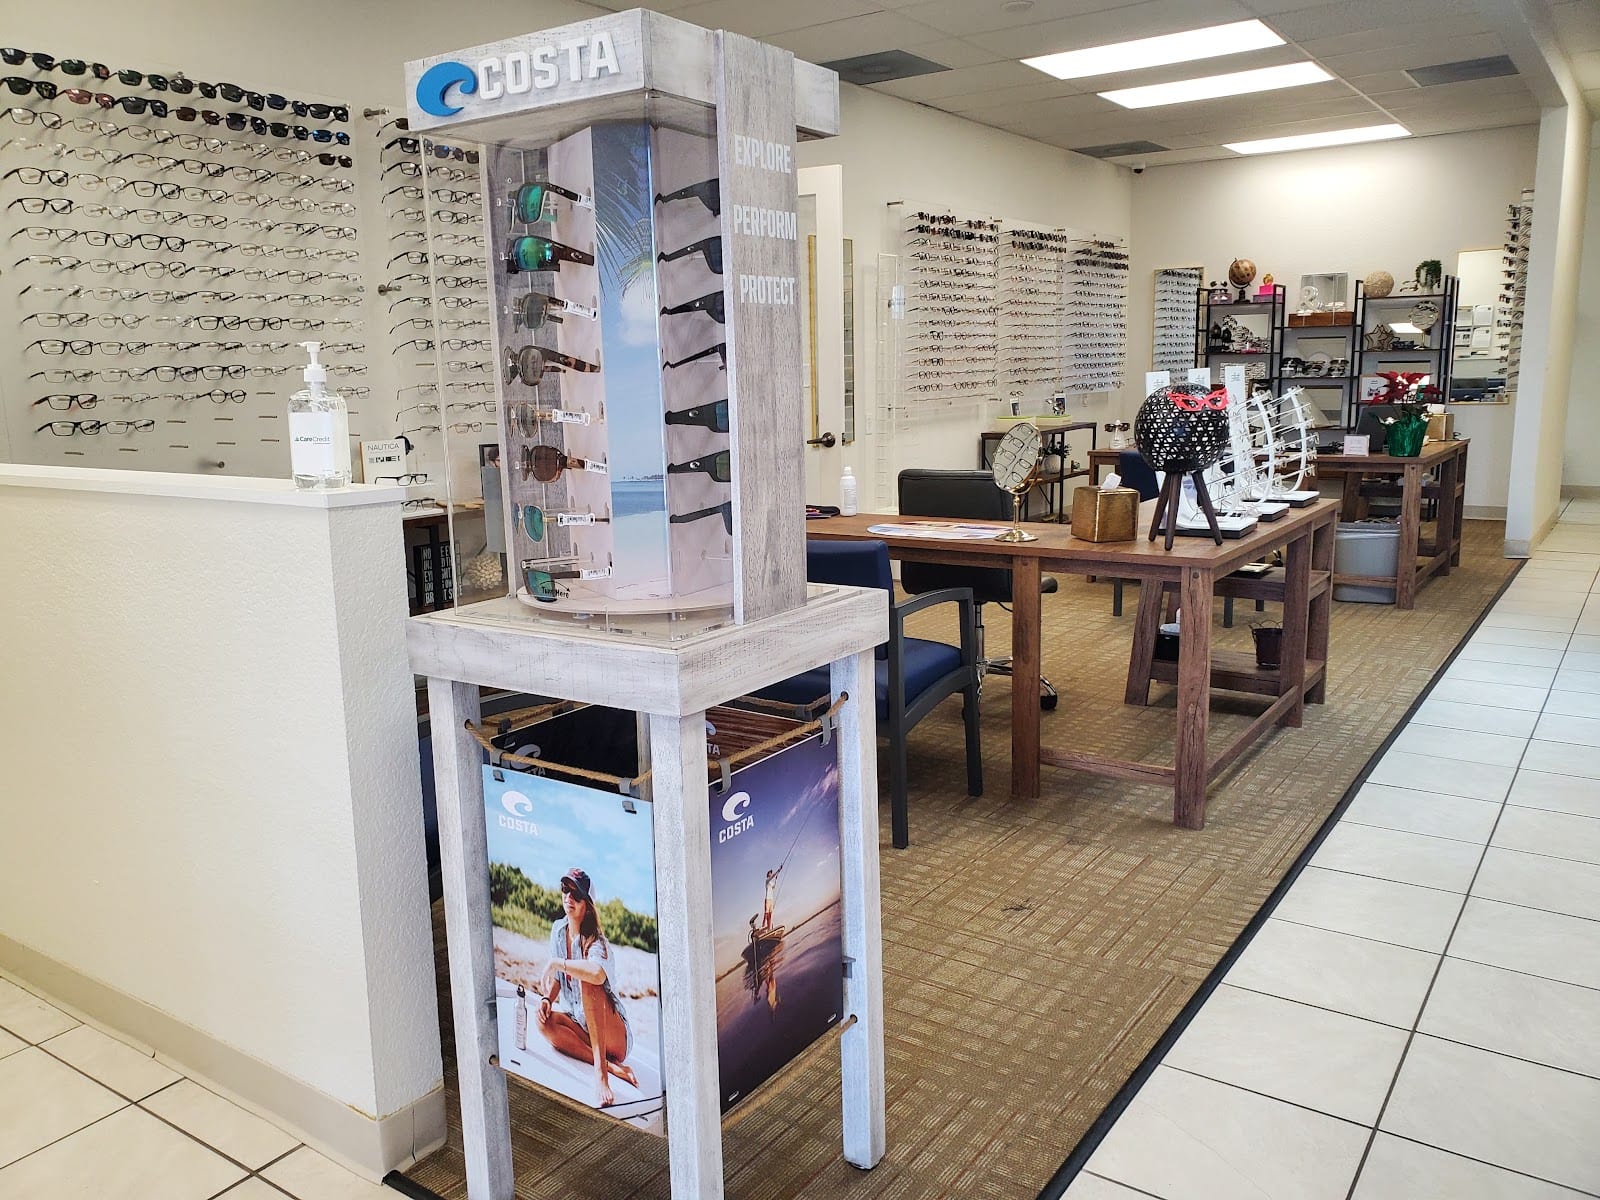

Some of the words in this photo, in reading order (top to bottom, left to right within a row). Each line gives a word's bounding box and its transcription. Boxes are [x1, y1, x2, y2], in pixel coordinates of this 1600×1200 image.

[478, 32, 620, 99] COSTA
[735, 134, 791, 174] EXPLORE
[733, 204, 797, 240] PERFORM
[740, 275, 795, 304] PROTECT
[499, 815, 539, 836] COSTA
[718, 815, 754, 844] COSTA
